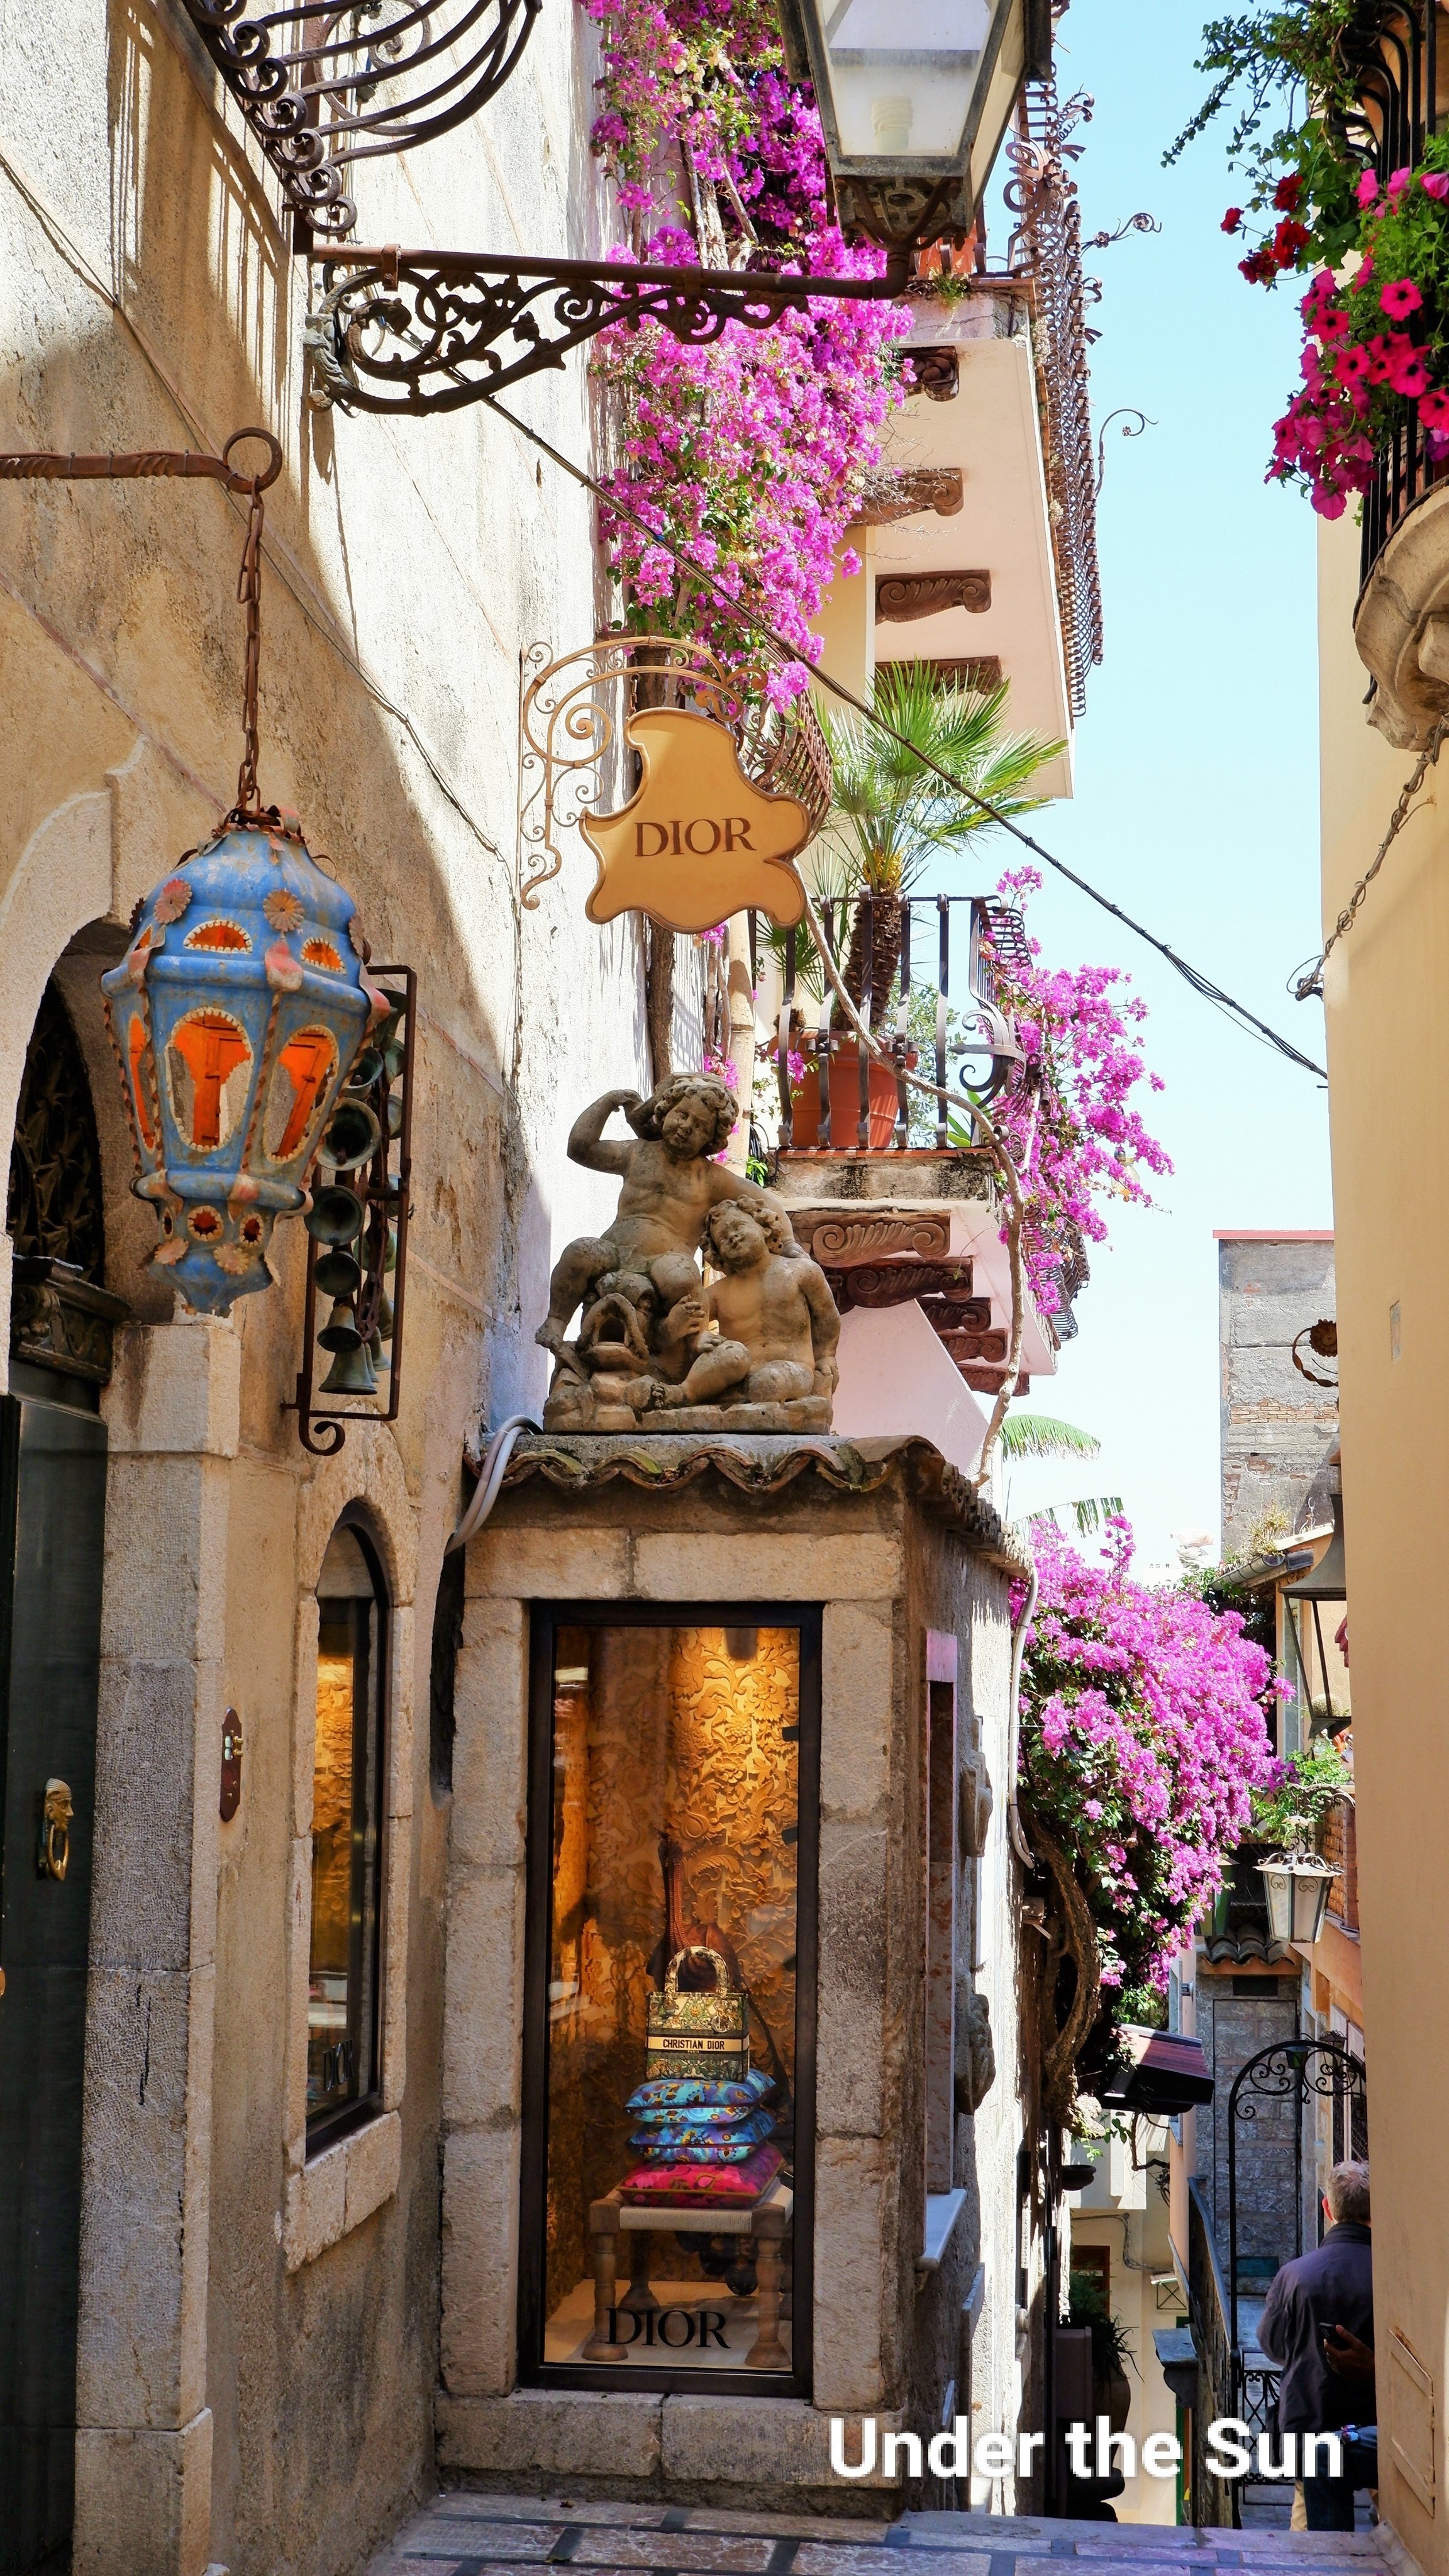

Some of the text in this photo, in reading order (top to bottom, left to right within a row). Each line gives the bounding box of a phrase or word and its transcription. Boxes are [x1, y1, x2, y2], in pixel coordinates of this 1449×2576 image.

[634, 817, 757, 857] DIOR
[663, 2039, 724, 2050] CHRISTIAN DIOR
[322, 2040, 353, 2094] DIOR
[605, 2307, 731, 2349] DIOR
